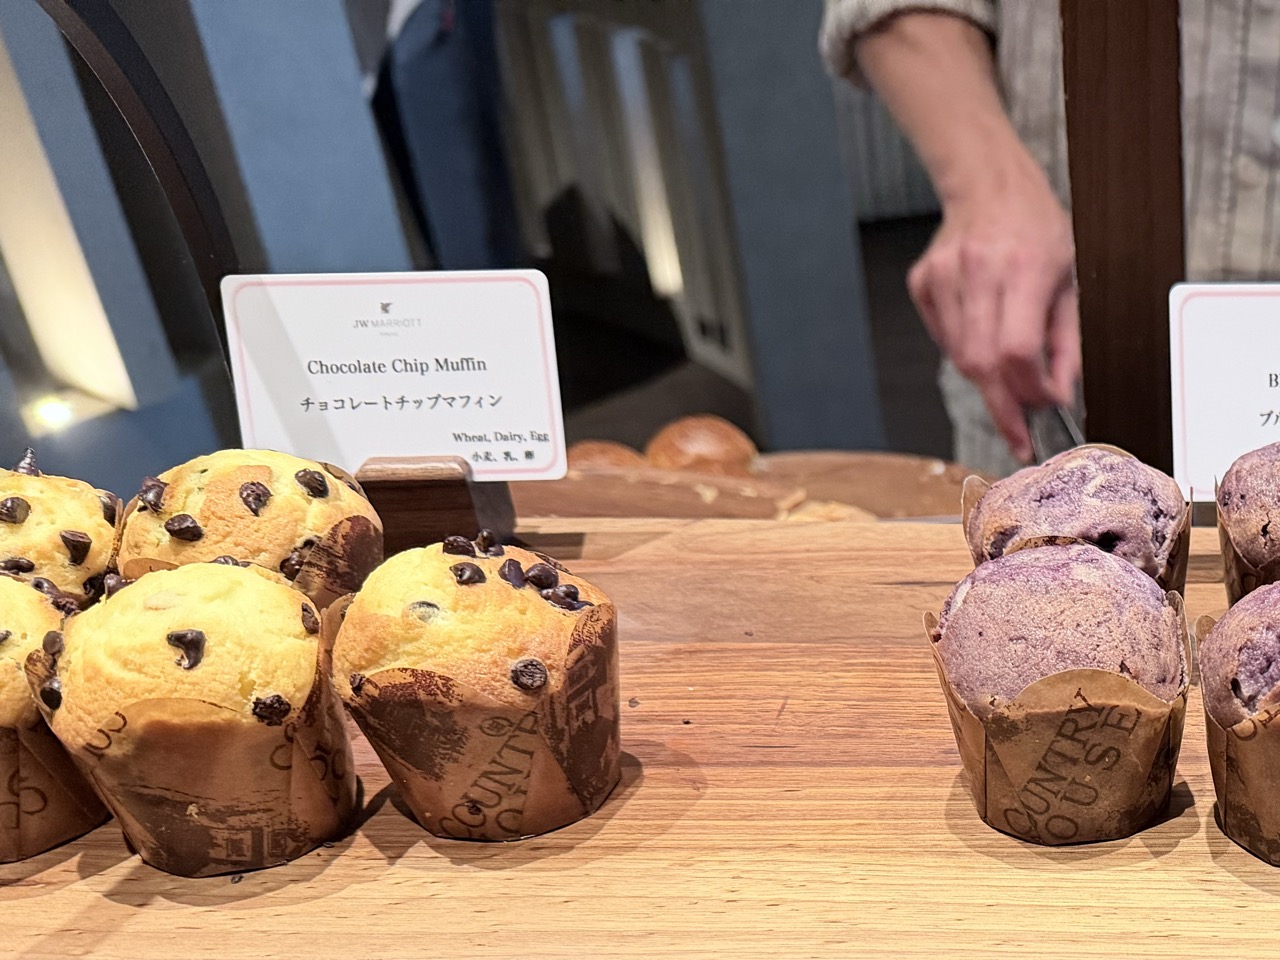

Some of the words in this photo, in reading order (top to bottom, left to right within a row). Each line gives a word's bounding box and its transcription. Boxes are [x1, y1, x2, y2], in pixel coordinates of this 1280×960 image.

[353, 319, 369, 328] JW
[307, 360, 387, 375] Chocolate
[391, 358, 429, 376] Chip
[434, 357, 487, 372] Muffin
[300, 394, 503, 413] チョコレートチップマフィン
[452, 432, 491, 443] Wheat,
[494, 431, 527, 443] Dairy,
[530, 430, 550, 442] Egg
